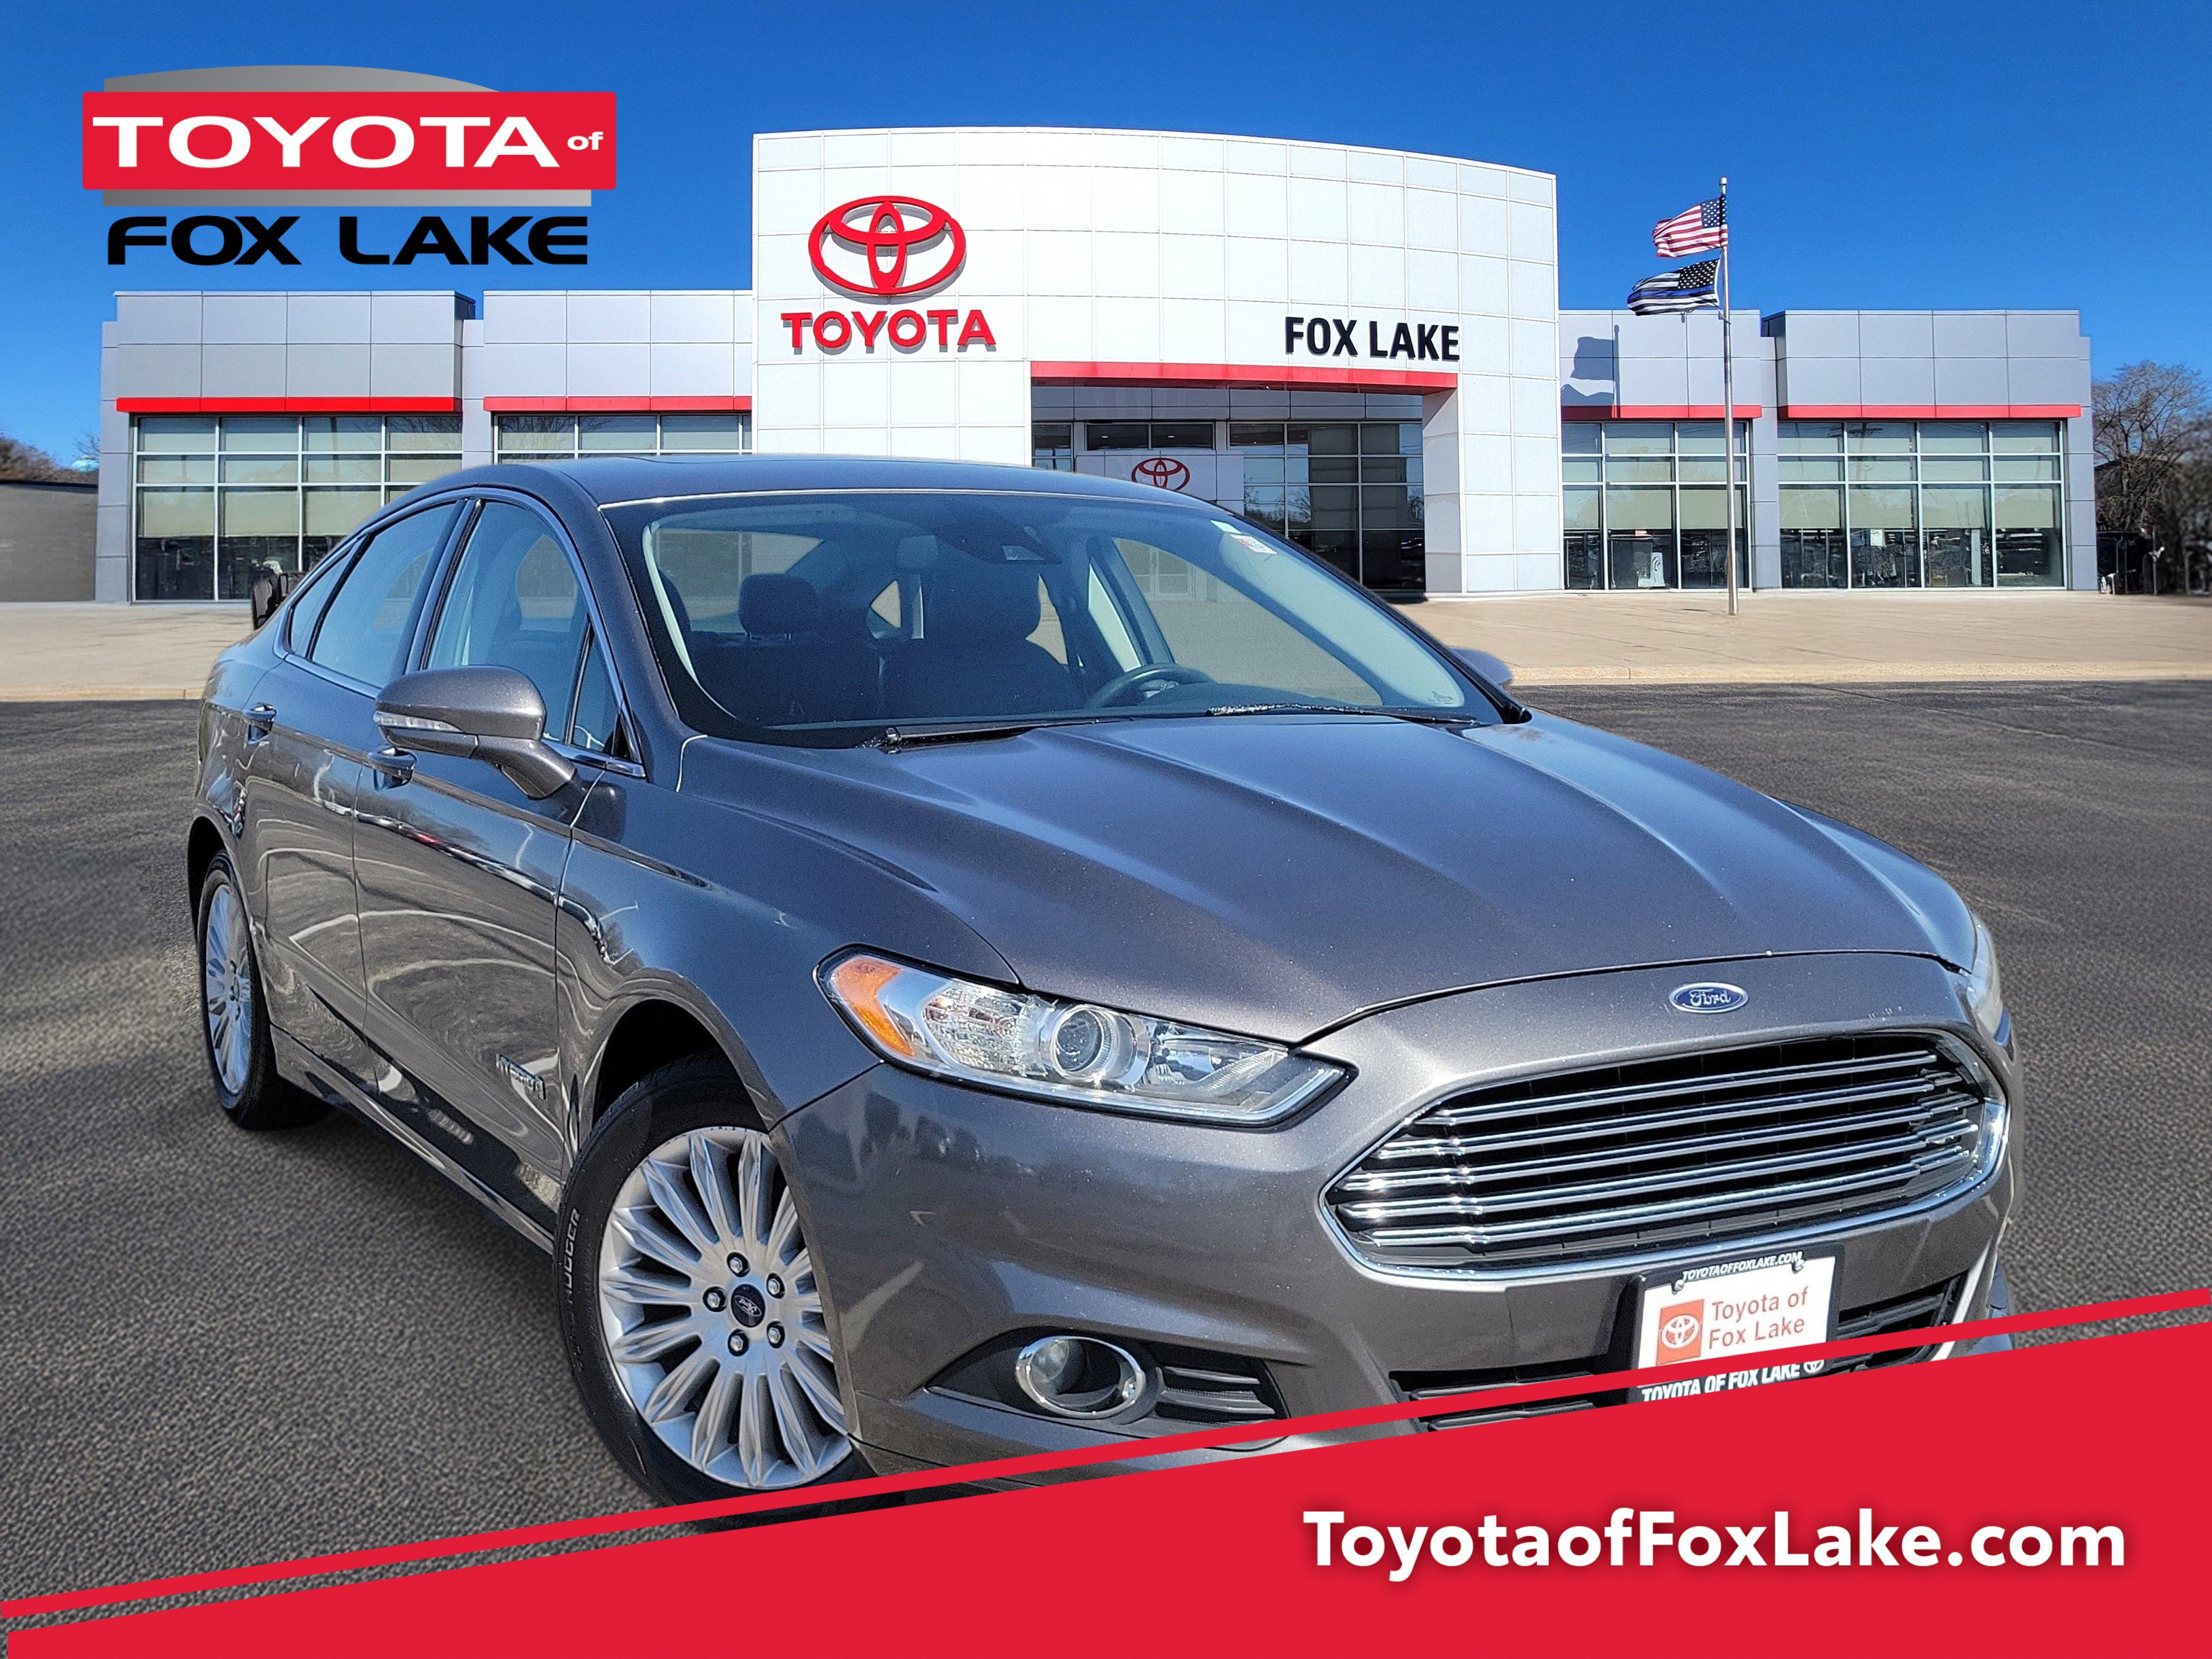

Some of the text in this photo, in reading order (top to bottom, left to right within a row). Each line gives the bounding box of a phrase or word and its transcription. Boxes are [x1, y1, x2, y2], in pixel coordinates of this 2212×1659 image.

[781, 309, 996, 349] TOYOTA
[1285, 316, 1460, 361] FOX LAKE
[1689, 988, 1732, 1007] Ford
[1682, 1251, 1803, 1281] TOYOTAOFFOXLAKE.COM
[1711, 1286, 1809, 1323] Toyota of
[1708, 1316, 1805, 1350] Fox Lake
[1641, 1363, 1801, 1402] TOYOTA OF FOX LAKE
